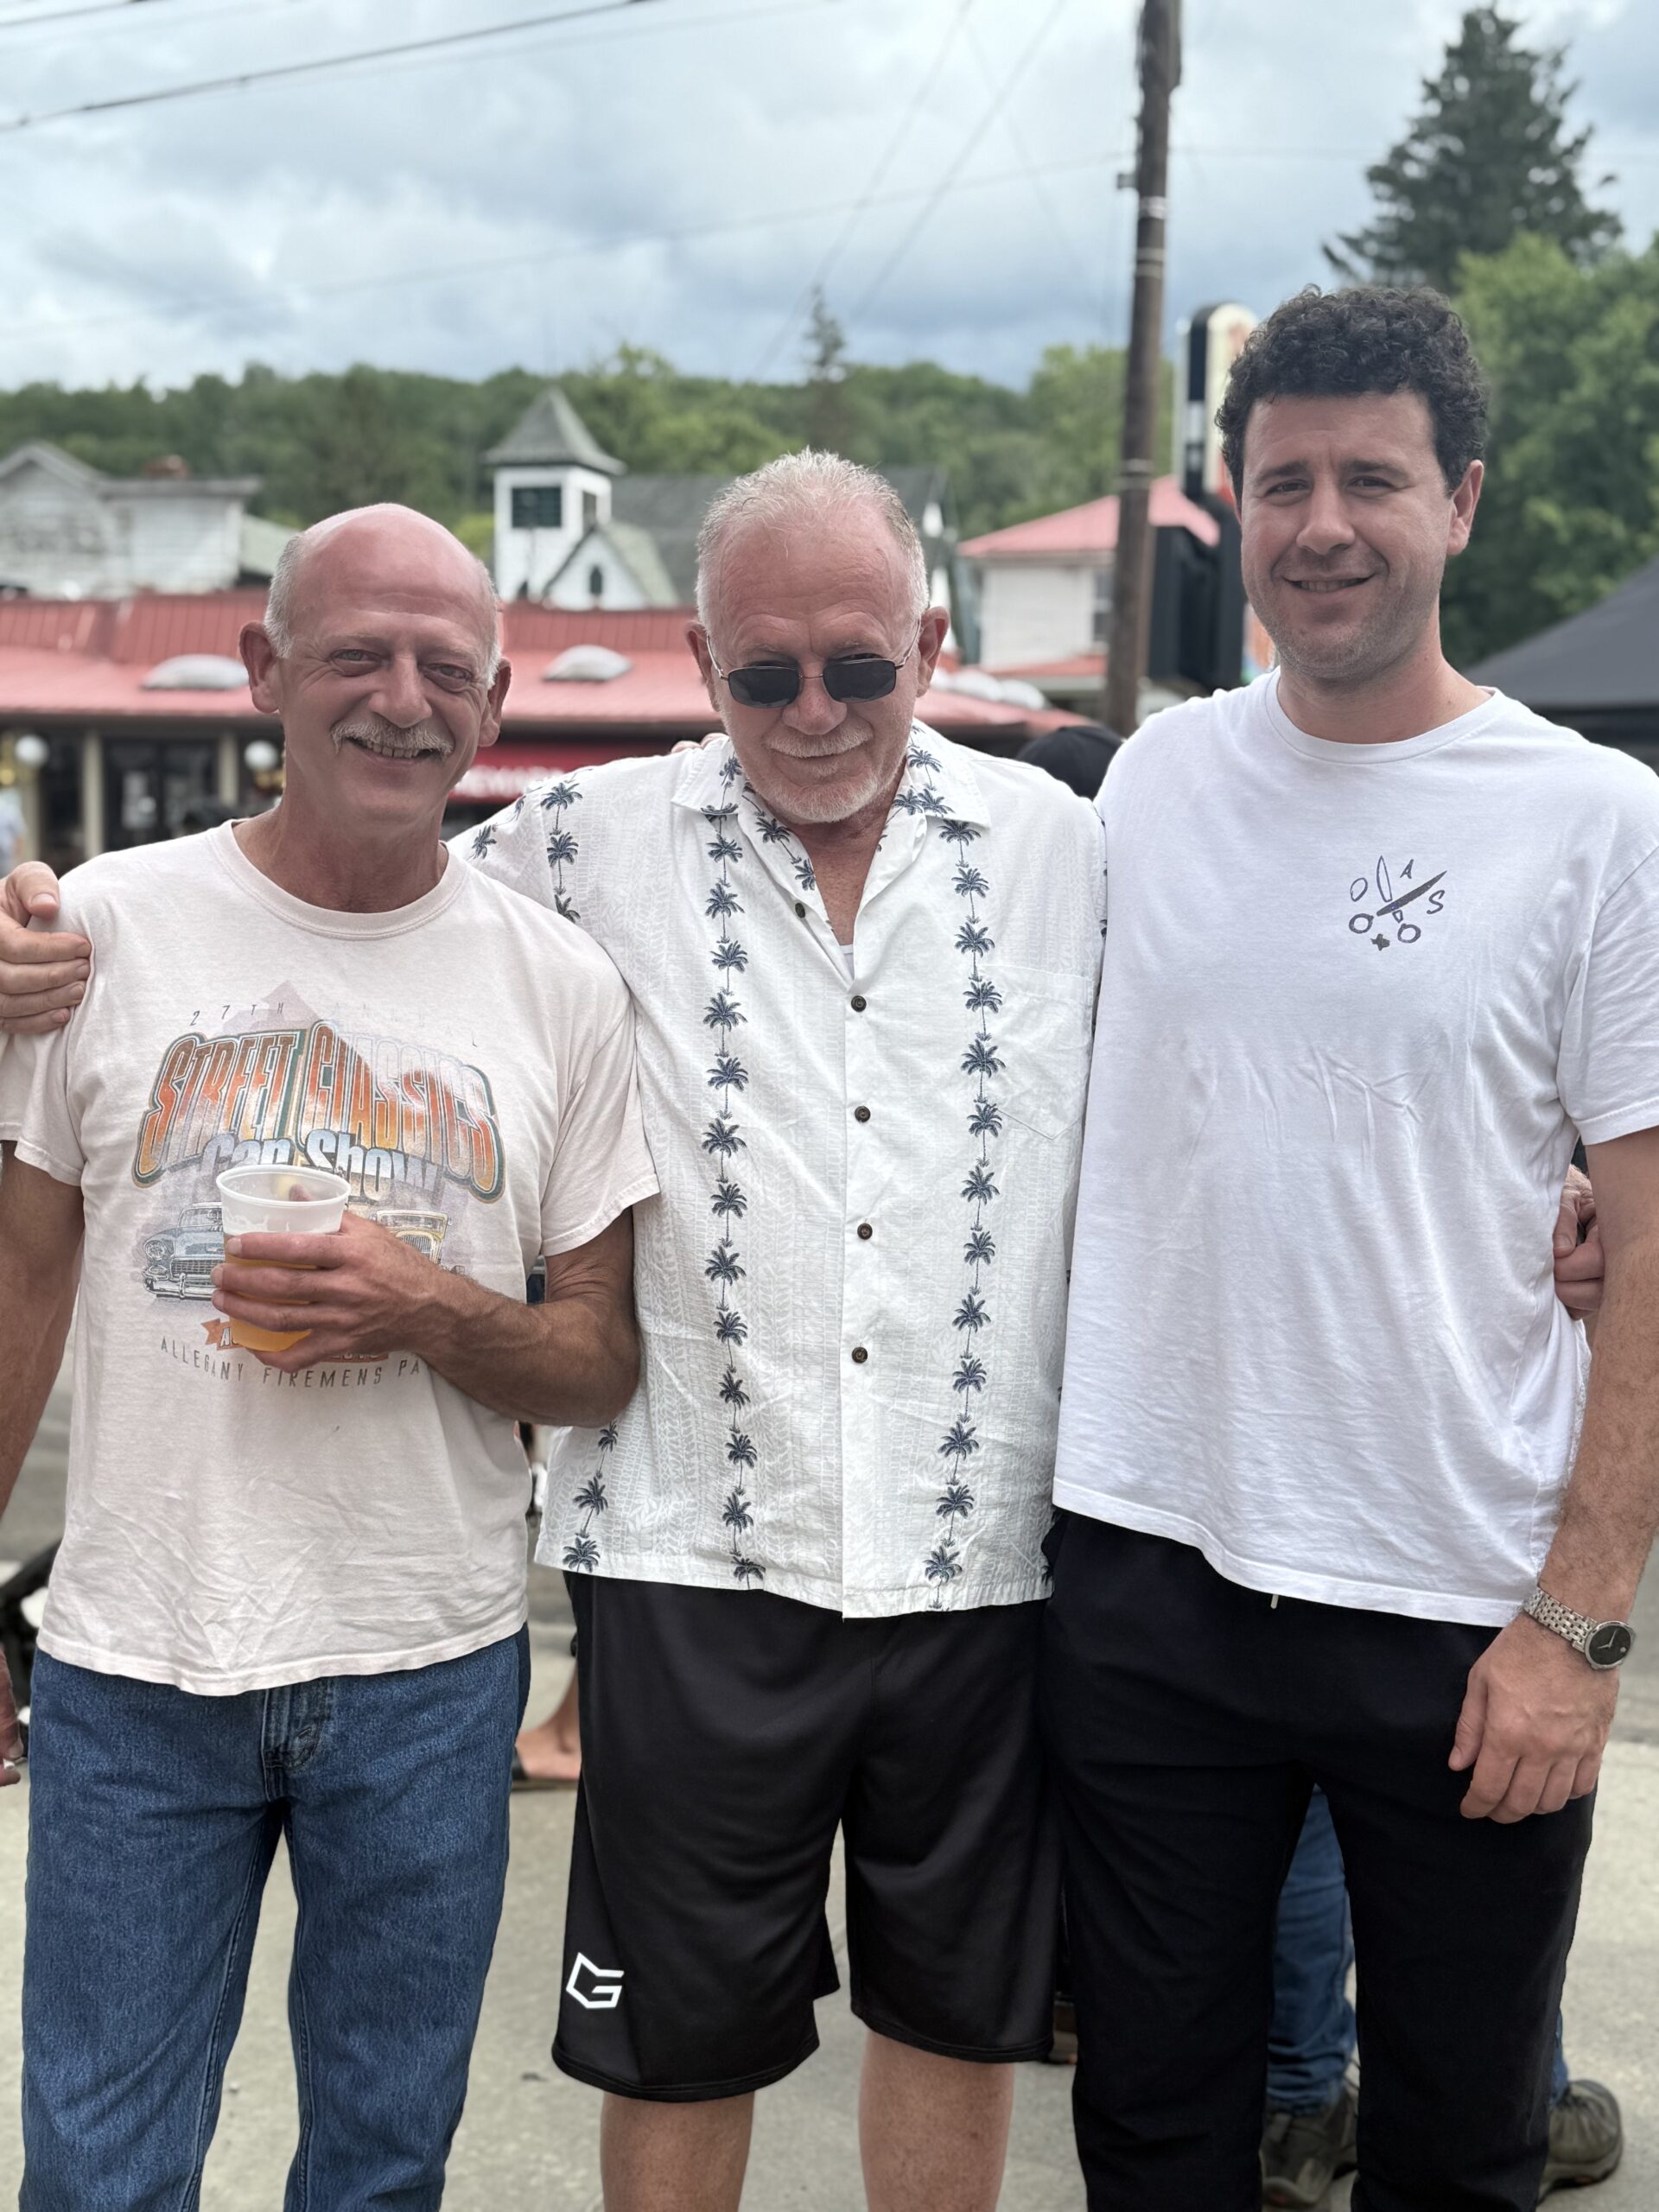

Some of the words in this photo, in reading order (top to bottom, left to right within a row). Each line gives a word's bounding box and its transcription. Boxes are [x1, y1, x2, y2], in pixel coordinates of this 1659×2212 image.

[189, 1001, 284, 1027] 27TH
[136, 1029, 304, 1180] STREET
[298, 1020, 501, 1196] CLASSICS
[306, 1127, 444, 1201] Show
[161, 1336, 244, 1382] ALLEGANY
[263, 1366, 383, 1389] FIREMENS
